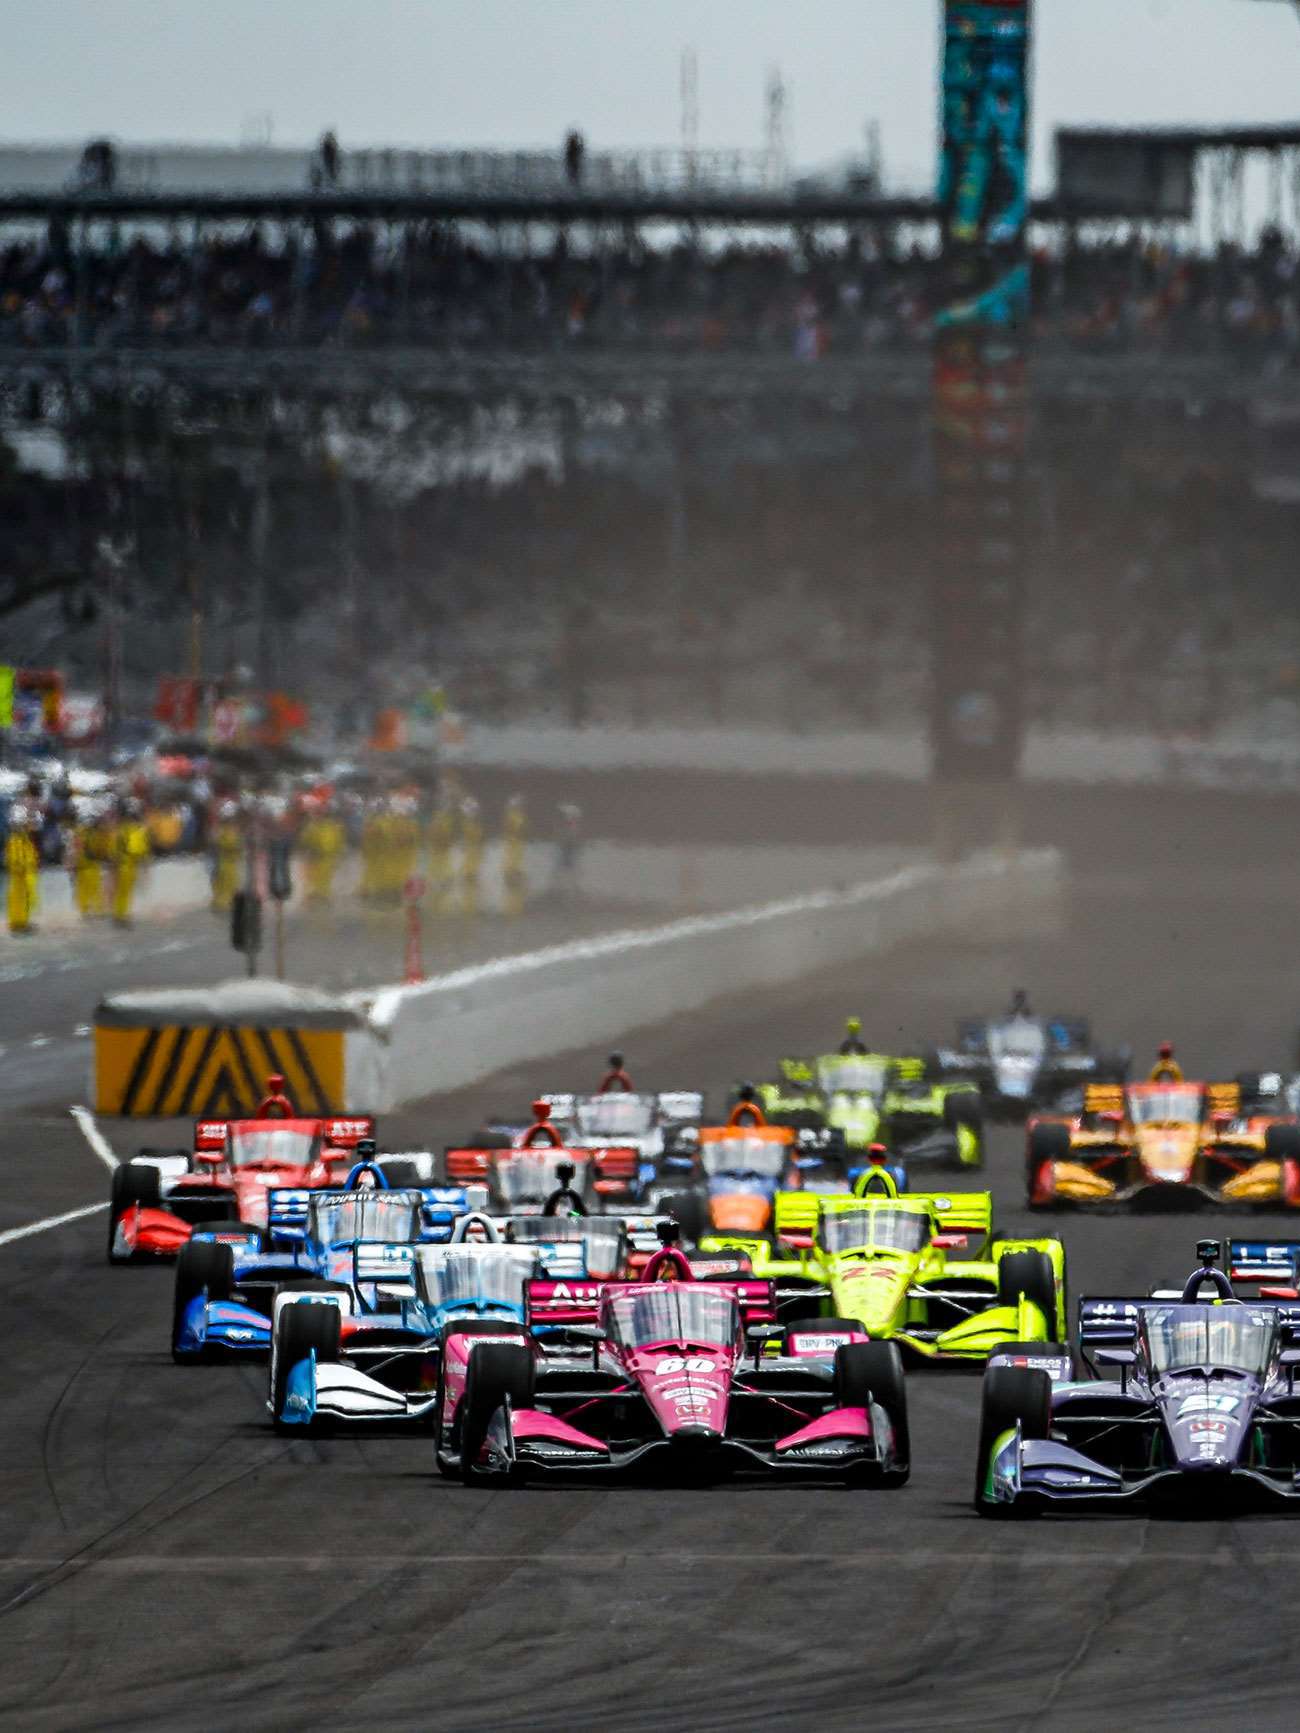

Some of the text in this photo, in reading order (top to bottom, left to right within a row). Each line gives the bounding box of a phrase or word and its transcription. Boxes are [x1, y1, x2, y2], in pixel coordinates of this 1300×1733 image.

[841, 1266, 897, 1281] 22
[656, 1357, 716, 1376] 60
[1177, 1394, 1240, 1416] 51
